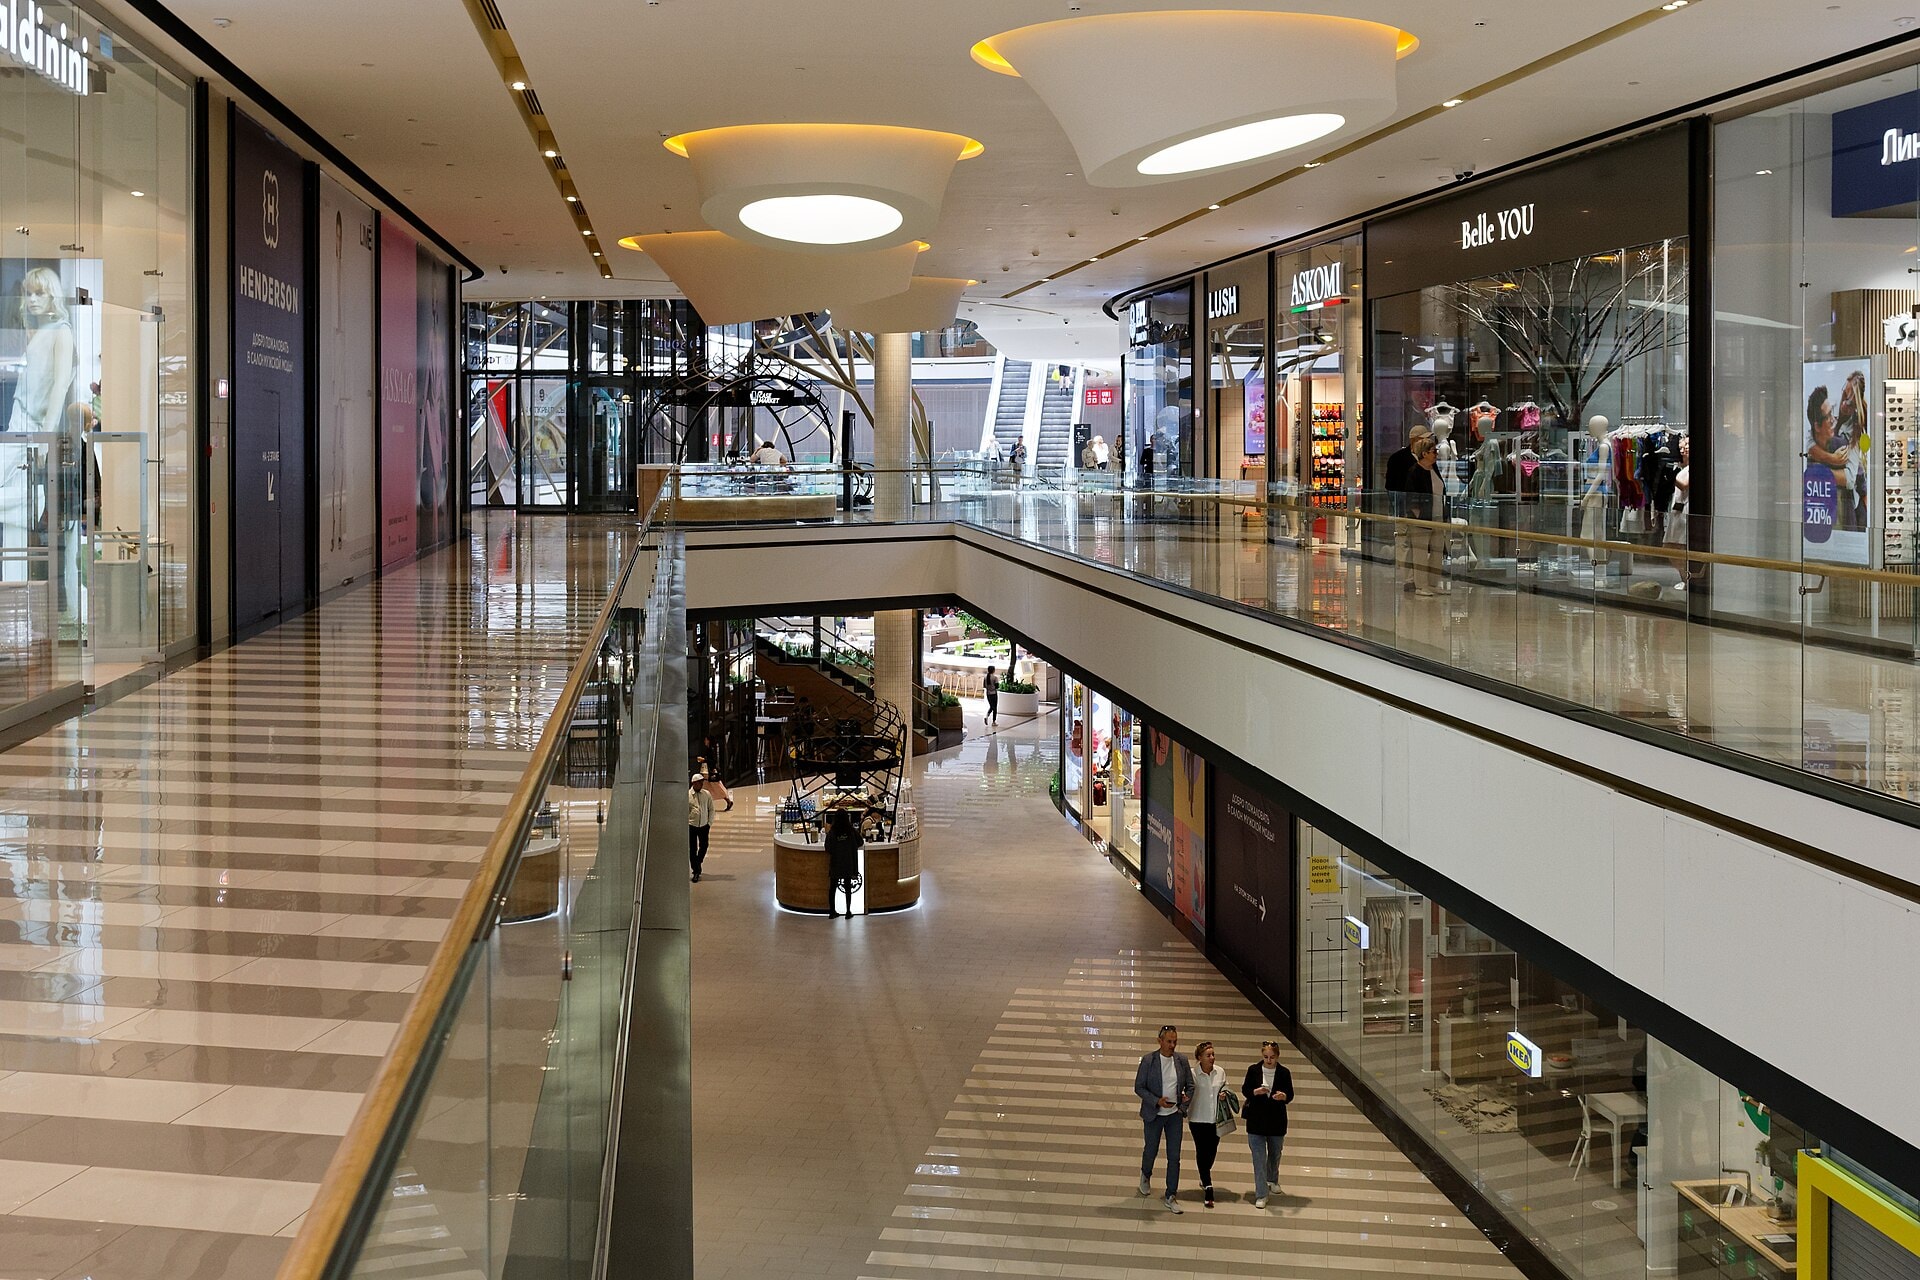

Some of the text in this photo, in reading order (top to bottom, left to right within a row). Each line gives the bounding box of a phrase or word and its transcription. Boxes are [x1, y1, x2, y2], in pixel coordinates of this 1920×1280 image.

[1461, 203, 1535, 250] Belle YOU
[239, 264, 299, 315] HENDERSON
[1290, 261, 1342, 307] ASKOMI
[1208, 285, 1238, 319] LUSH
[1806, 480, 1832, 498] SALE
[1806, 508, 1832, 525] 20%
[1509, 1042, 1530, 1067] IKEA
